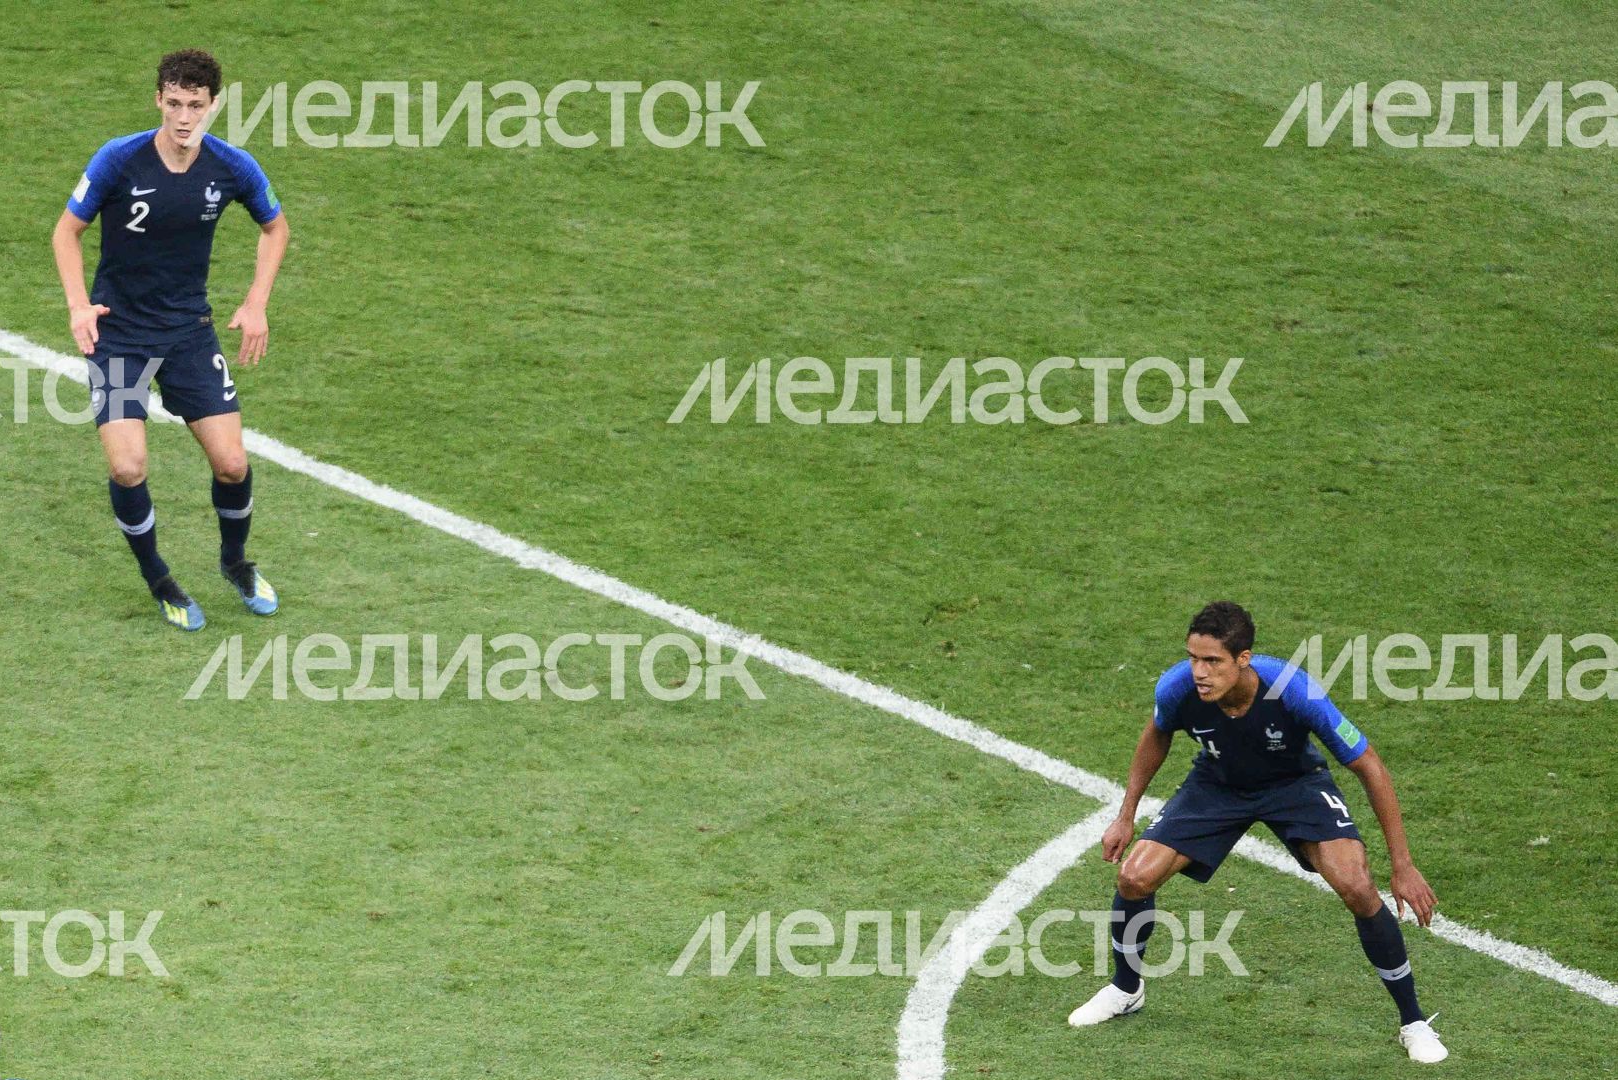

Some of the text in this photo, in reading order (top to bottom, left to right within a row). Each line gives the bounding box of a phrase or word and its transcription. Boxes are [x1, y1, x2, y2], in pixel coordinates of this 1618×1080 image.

[126, 201, 150, 233] 2
[212, 354, 235, 388] 2
[1320, 791, 1350, 818] 4
